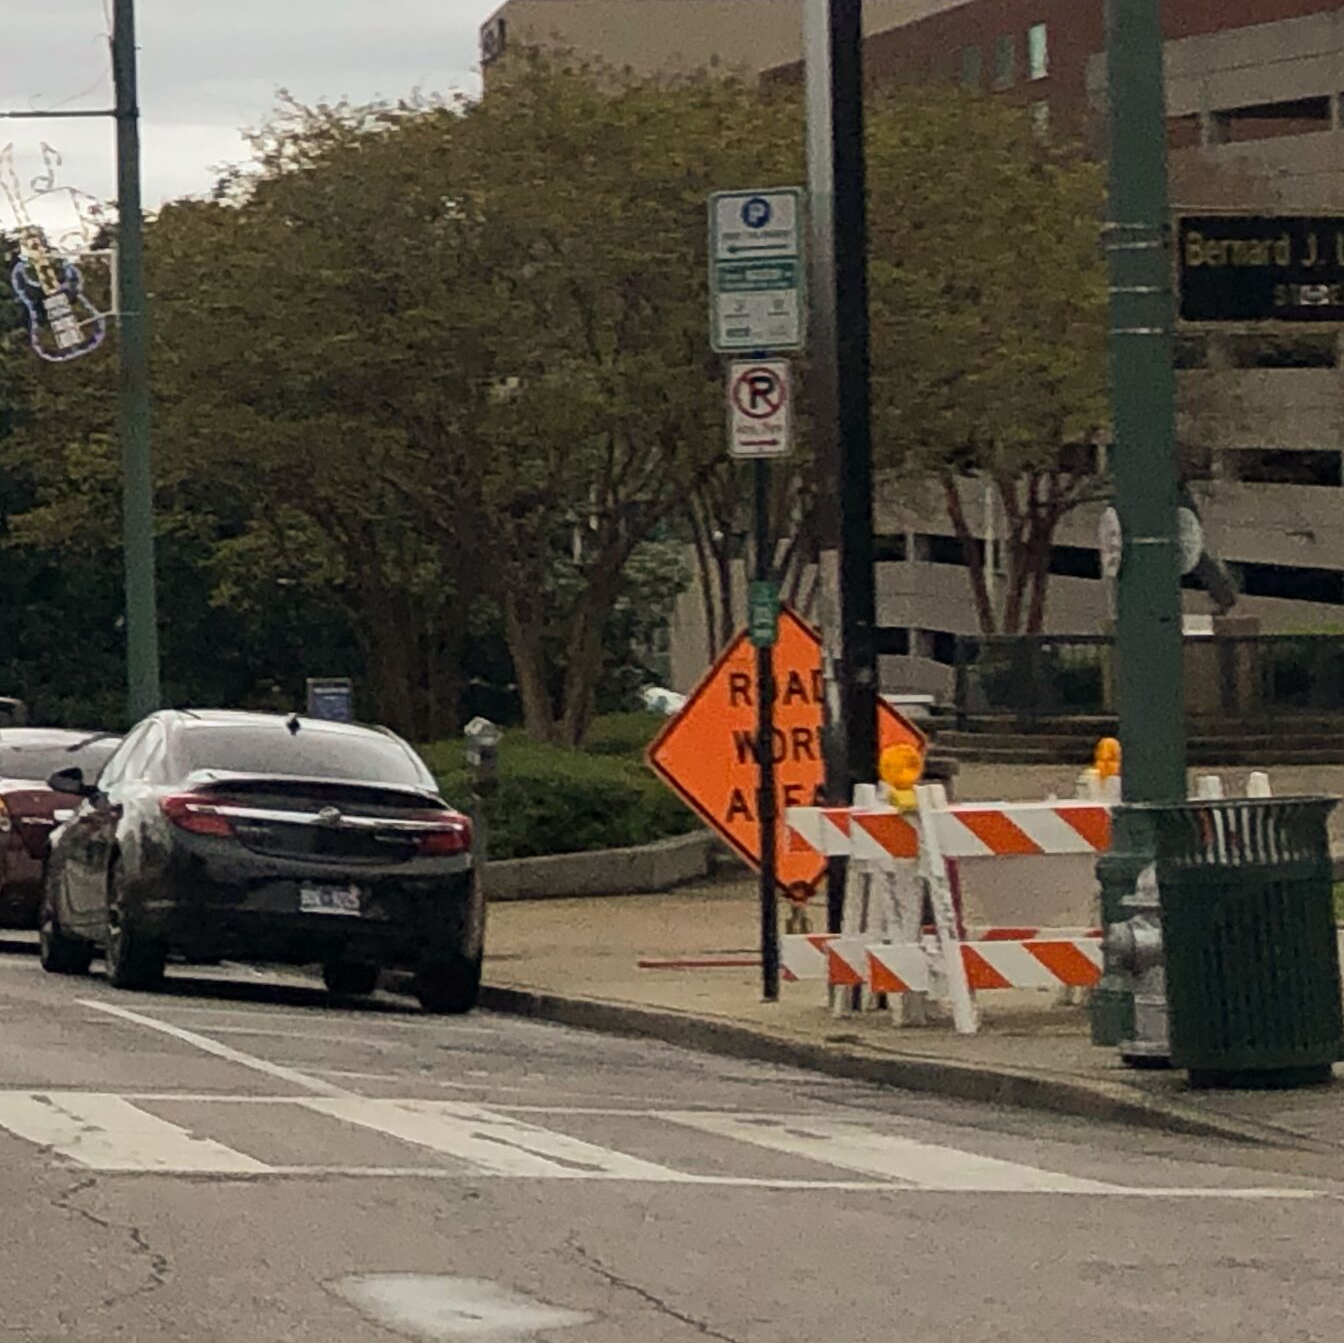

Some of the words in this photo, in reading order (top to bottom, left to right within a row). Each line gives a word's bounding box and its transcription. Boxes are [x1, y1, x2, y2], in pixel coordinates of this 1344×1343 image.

[729, 669, 825, 707] RAD
[731, 727, 824, 764] WOR
[726, 783, 828, 822] AE
